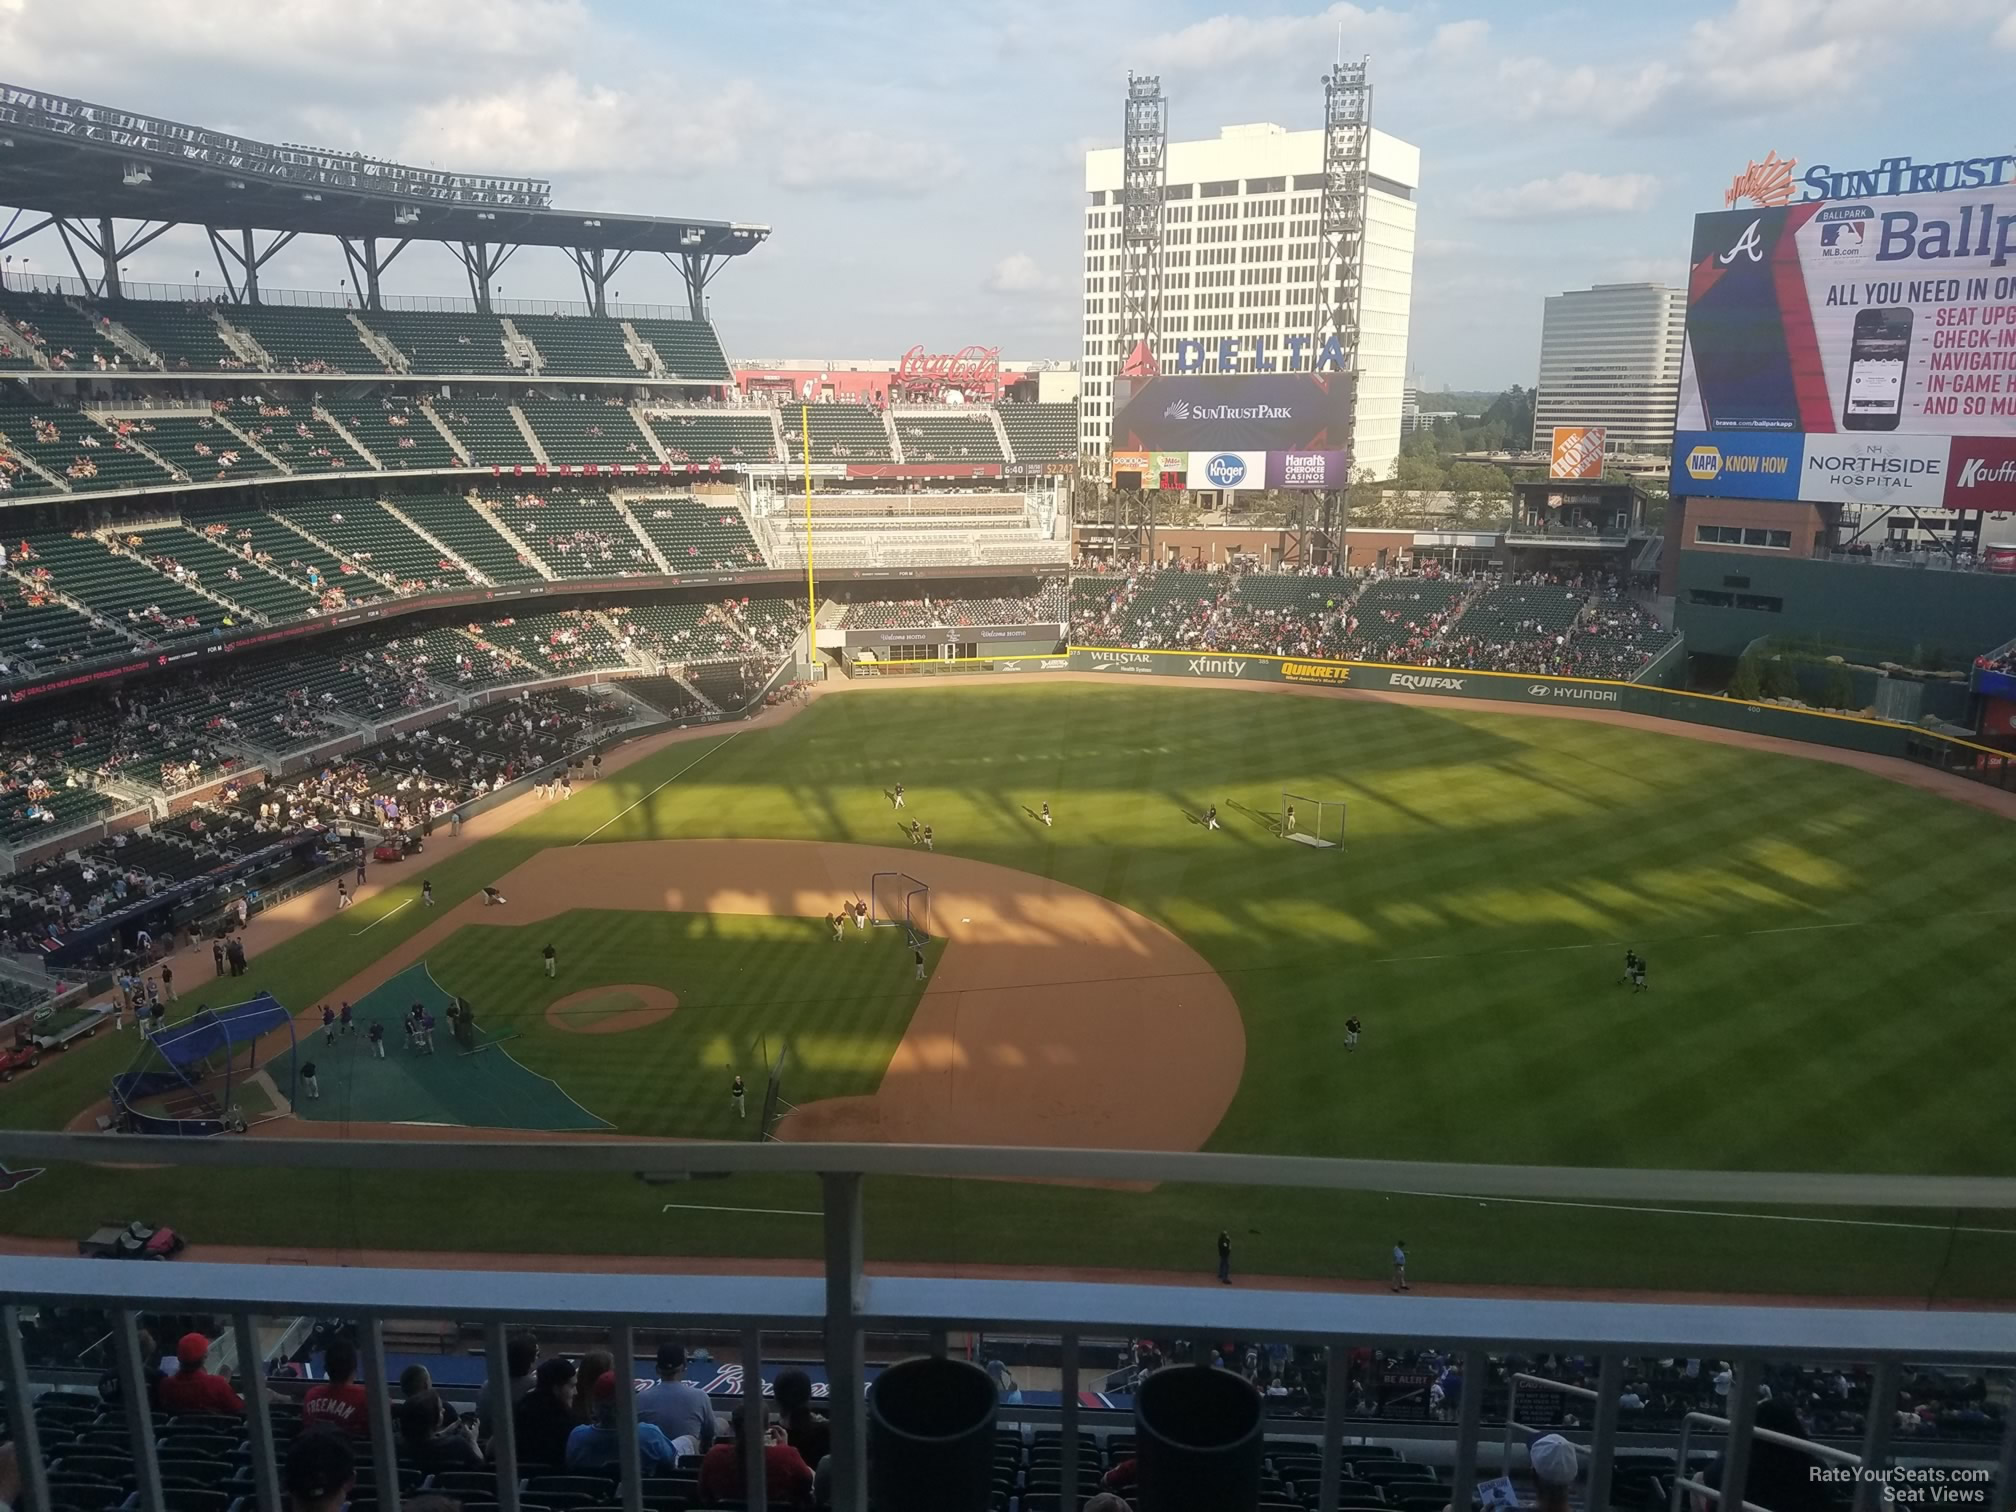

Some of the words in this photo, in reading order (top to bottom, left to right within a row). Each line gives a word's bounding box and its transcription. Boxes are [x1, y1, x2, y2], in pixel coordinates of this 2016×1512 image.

[1822, 208, 1867, 221] BALLPARK
[1822, 248, 1859, 257] MLB.com
[1826, 284, 1859, 306] ALL
[1865, 282, 1903, 304] YOU
[1908, 279, 1961, 303] NEED
[1966, 278, 1989, 300] IN
[1935, 307, 1978, 327] SEAT
[1177, 335, 1345, 371] DELTA
[1927, 374, 2003, 393] IN-GAME
[1923, 397, 1958, 415] AND
[1963, 397, 1985, 415] SO
[1715, 420, 1793, 428] braves.com/ballparkapp
[1558, 433, 1580, 453] THE
[1285, 454, 1325, 466] Harrah's
[1552, 427, 1604, 477] HOME
[491, 464, 500, 476] 3
[514, 464, 522, 476] 6
[560, 464, 572, 476] 21
[583, 464, 598, 476] 29
[635, 464, 649, 475] 35
[734, 463, 747, 474] 42
[1004, 465, 1024, 474] 6:40
[1285, 466, 1325, 474] CHEROKEE
[1571, 446, 1604, 478] DEPOT
[1692, 455, 1717, 471] NAPA
[1725, 456, 1759, 473] KNOW
[1761, 456, 1788, 473] HOW
[1809, 456, 1941, 474] NORTHSIDE
[1210, 459, 1243, 484] Kroger
[1830, 475, 1913, 488] HOSPITAL
[1091, 651, 1150, 664] WELLSTAR
[1188, 657, 1247, 676] xfinity
[1281, 662, 1350, 679] QUIKRETE
[1389, 673, 1464, 690] EQUIFAX
[1554, 687, 1617, 702] HYUNDAI
[1384, 1375, 1397, 1384] BE
[1399, 1375, 1429, 1385] ALERT
[307, 1398, 356, 1419] FREEMAN
